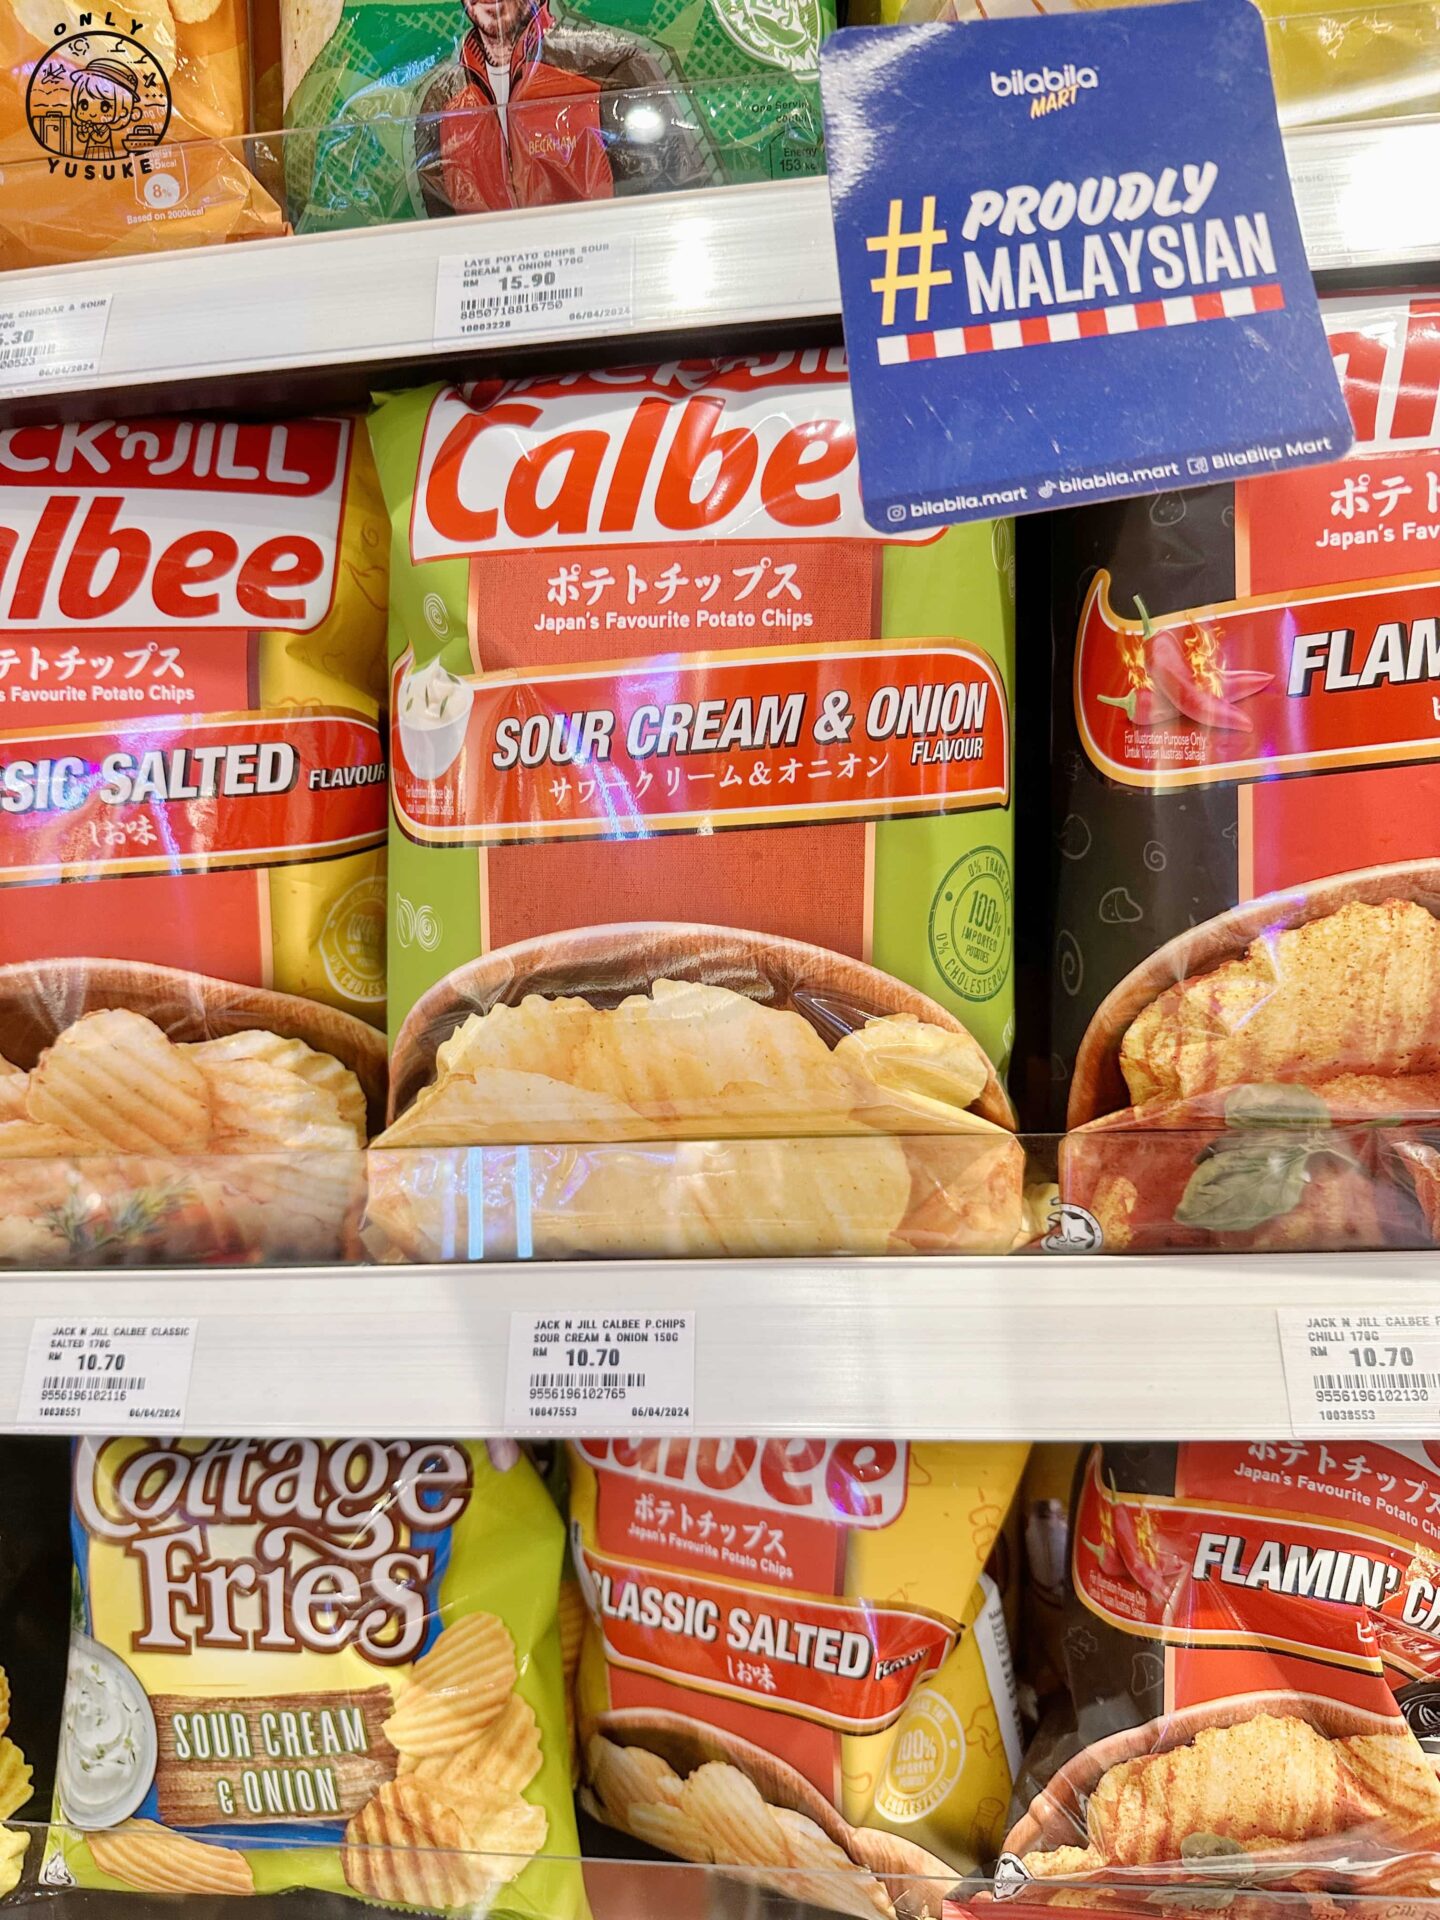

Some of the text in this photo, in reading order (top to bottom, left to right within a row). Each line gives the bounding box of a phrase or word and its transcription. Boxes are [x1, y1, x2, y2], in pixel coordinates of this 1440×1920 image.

[990, 64, 1099, 97] bilabila
[1030, 86, 1079, 119] MART
[961, 161, 1219, 241] PROUDLY
[127, 207, 205, 224] Based on 2000kcal
[463, 266, 500, 277] CREAM
[518, 259, 552, 270] ONION
[558, 256, 583, 266] 170G
[464, 243, 609, 268] LAYS POTATO CHIPS SOUR
[963, 212, 1278, 314] MALAYSIAN
[463, 271, 556, 291] RM 15.90
[18, 305, 64, 318] CHEDDAR
[80, 299, 107, 310] SOUR
[460, 299, 563, 320] 8850718816750
[569, 307, 631, 321] 06/04/2024
[426, 396, 857, 542] Calbe
[910, 436, 1333, 518] bilabila.mart bilabila.mart BilaBila Mart
[1315, 523, 1395, 550] Japan's
[0, 496, 324, 619] lbee
[547, 556, 803, 606] ポテトチップス
[533, 608, 813, 634] Japan's Favourite Potato Chips
[12, 685, 87, 702] Favourite
[92, 684, 144, 701] Potato
[149, 684, 195, 704] Chips
[492, 681, 989, 771] SOUR CREAM & ONION
[911, 736, 984, 766] FLAVOUR
[1190, 732, 1206, 750] Only
[100, 742, 297, 806] SALTED
[308, 763, 387, 790] FLAVOUR
[89, 813, 158, 847] しお味
[967, 860, 982, 878] 0%
[968, 890, 1003, 938] 100%
[961, 925, 998, 952] IMPORTED
[945, 957, 1006, 994] CHOLESTEROL
[52, 1327, 190, 1336] JACK N JILL CALBEE CLASSIC
[534, 1319, 686, 1329] JACK N JILL CALBEE P.CHIPS
[1307, 1318, 1336, 1328] JACK
[1342, 1318, 1350, 1327] N
[1356, 1317, 1380, 1327] JILL
[1386, 1316, 1430, 1326] CALBEE
[50, 1339, 111, 1348] SALTED 170G
[533, 1332, 679, 1342] SOUR CREAM & ONION 150G
[1308, 1331, 1379, 1342] CHILLI 170G
[48, 1351, 126, 1370] RM 10.70
[532, 1347, 620, 1366] RM 10.70
[1310, 1346, 1414, 1367] RM 10.70
[41, 1390, 127, 1401] 9556196102116
[529, 1388, 626, 1399] 9556196102765
[1316, 1389, 1429, 1402] 9556196102130
[129, 1408, 181, 1417] 06/04/2024
[529, 1407, 690, 1416] 10047553 06/04/2024
[1320, 1410, 1376, 1420] 10038553
[1234, 1462, 1292, 1487] Japan's
[1297, 1475, 1371, 1507] Favourite
[1376, 1496, 1418, 1528] Potato
[633, 1492, 788, 1559] ポテトチップス
[628, 1521, 793, 1581] Japan's Favourite Potato Chips
[1192, 1532, 1402, 1611] FLAMIN'
[132, 1526, 430, 1662] Fries
[726, 1607, 874, 1681] SALTED
[725, 1655, 778, 1693] しお味
[172, 1707, 368, 1760] SOUR CREAM
[242, 1767, 339, 1814] ONION
